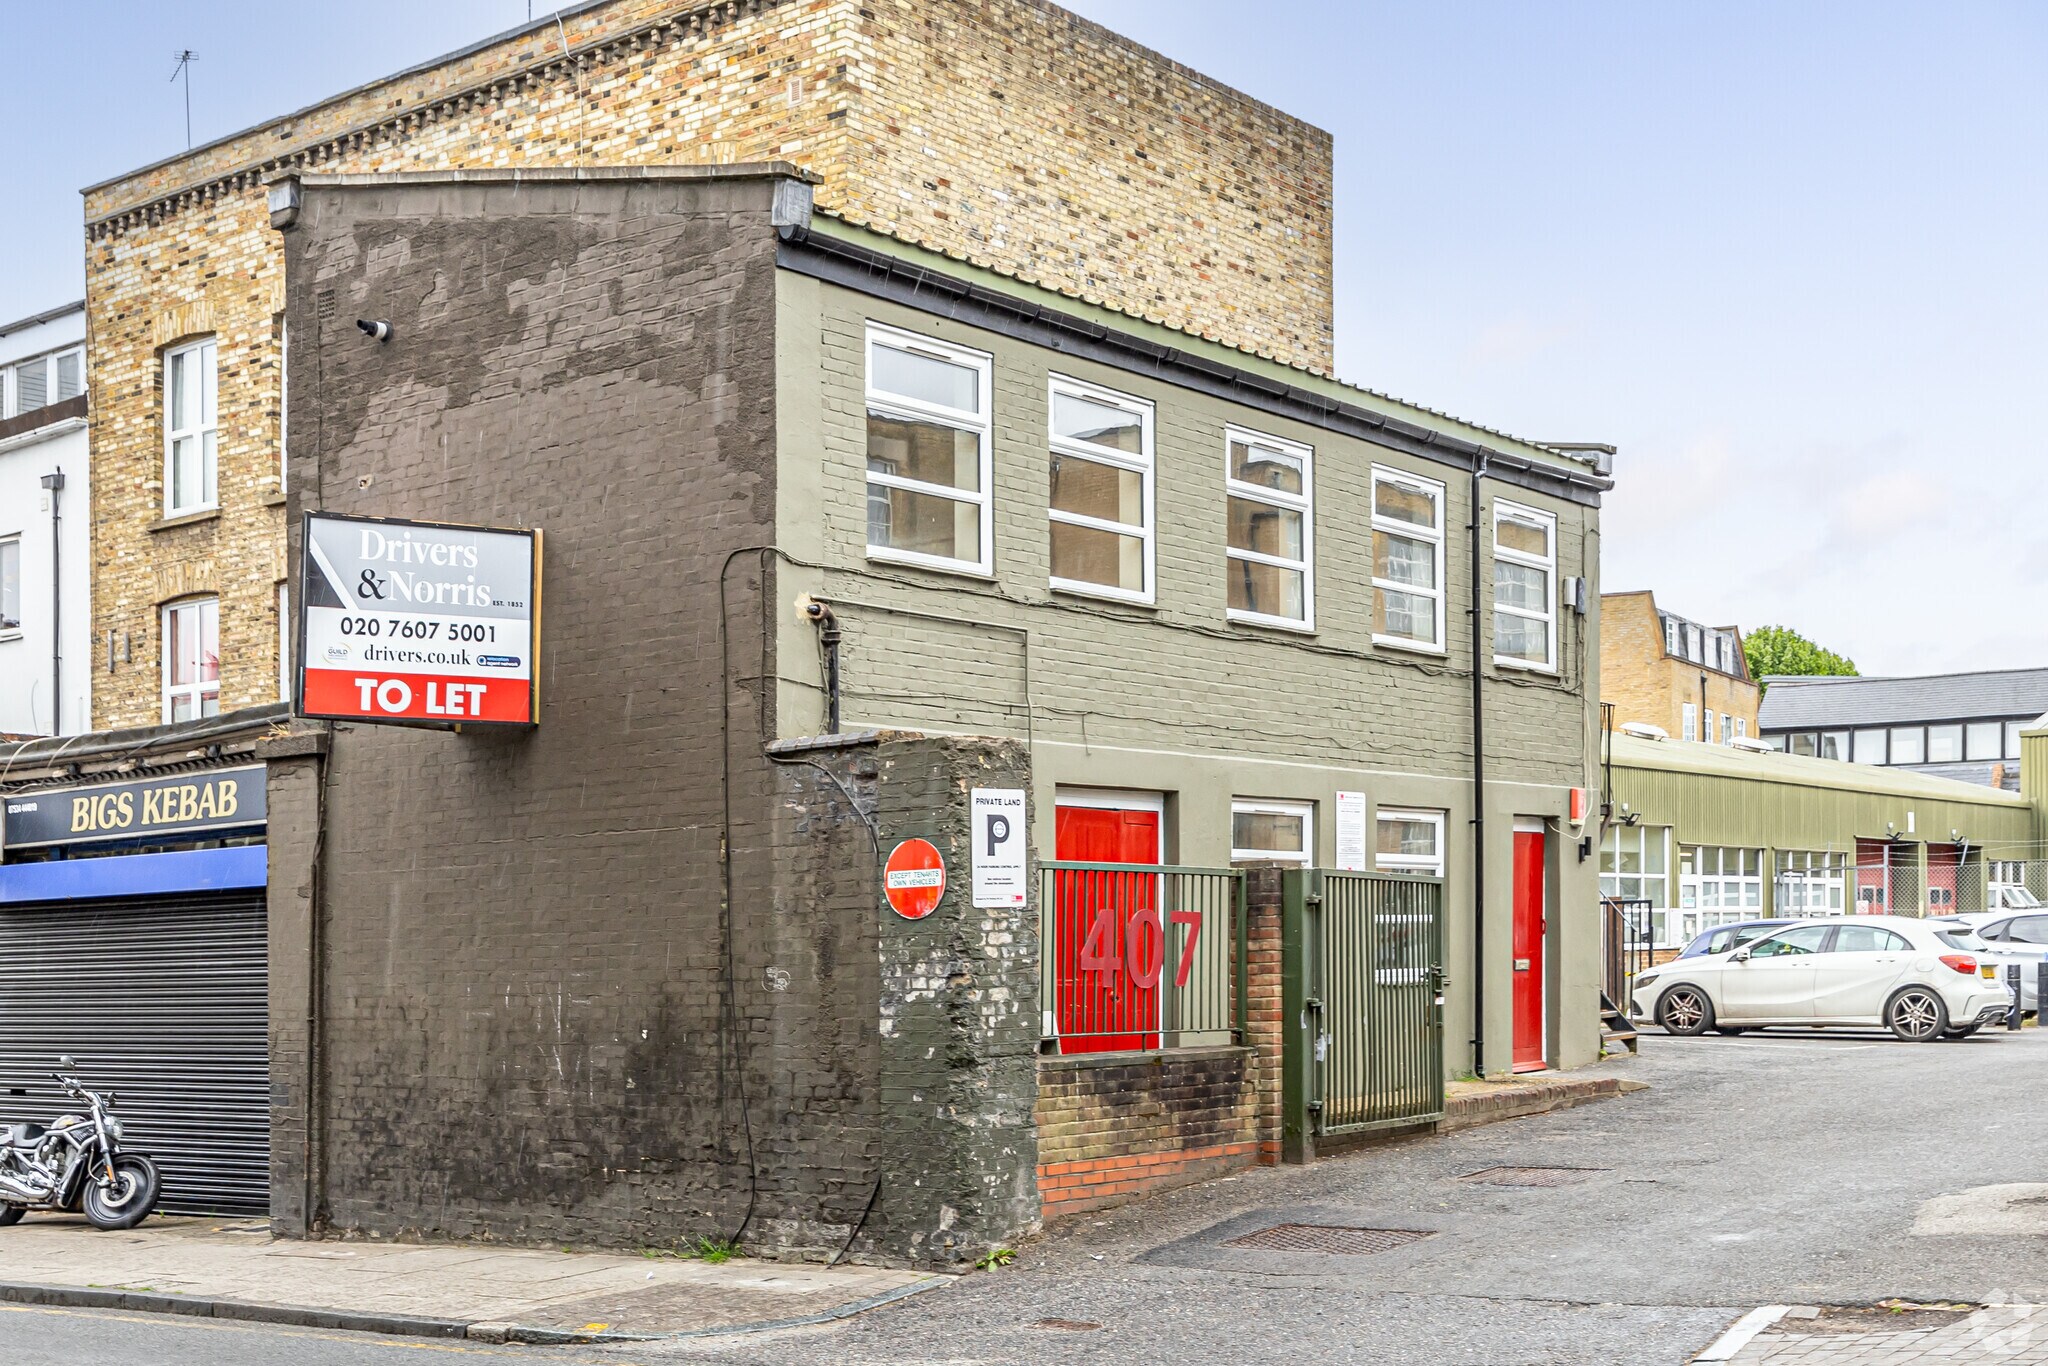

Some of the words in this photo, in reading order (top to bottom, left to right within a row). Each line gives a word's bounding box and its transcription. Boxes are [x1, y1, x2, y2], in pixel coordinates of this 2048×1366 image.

[359, 529, 478, 568] Drivers
[340, 617, 380, 636] 020
[388, 620, 440, 640] 7607
[448, 624, 496, 643] 5001
[364, 645, 471, 666] drivers.co.uk
[354, 678, 412, 713] TO
[425, 681, 487, 716] LET
[70, 791, 134, 832] BIGS
[140, 780, 238, 825] KEBAB
[976, 797, 1002, 806] PRIVATE
[1004, 798, 1021, 806] LAND
[987, 814, 1010, 856] P
[910, 878, 936, 886] VEHICLES
[914, 870, 939, 878] TENANTS
[1080, 908, 1203, 989] 407
